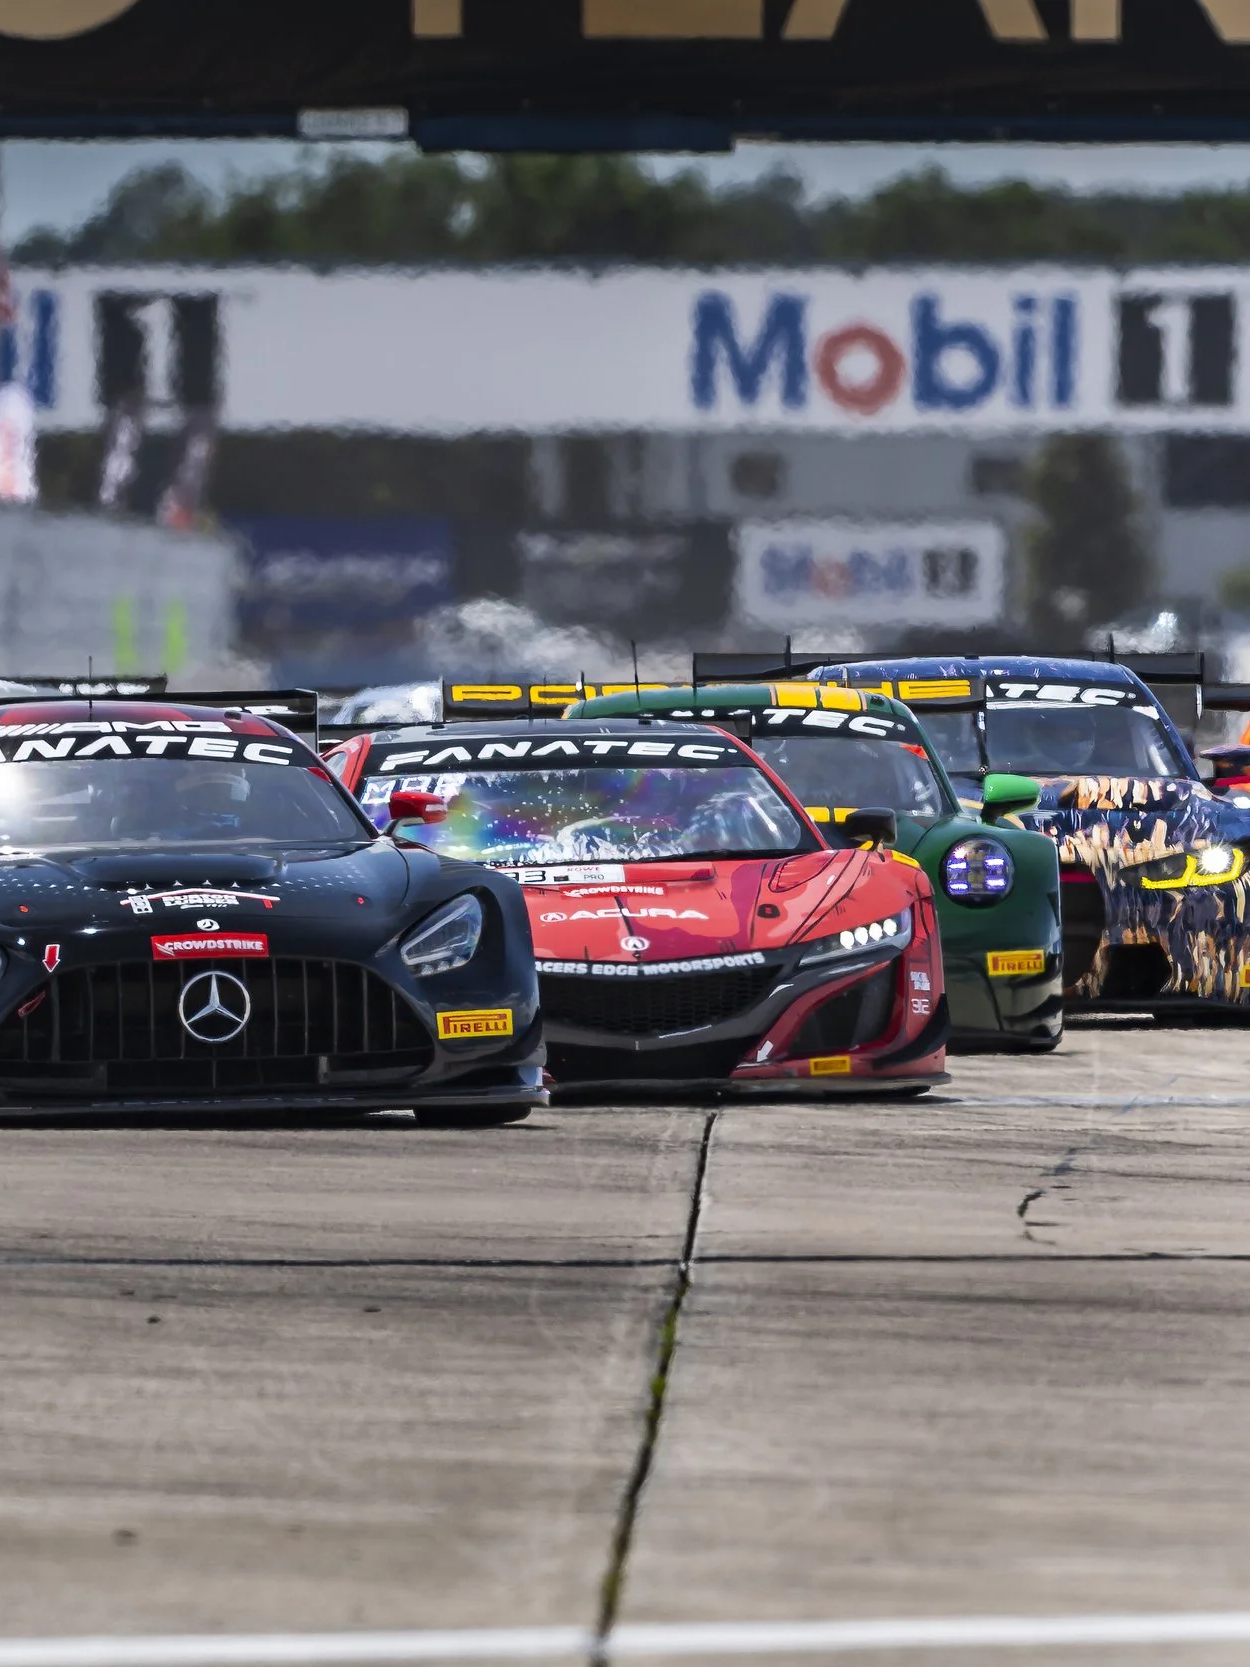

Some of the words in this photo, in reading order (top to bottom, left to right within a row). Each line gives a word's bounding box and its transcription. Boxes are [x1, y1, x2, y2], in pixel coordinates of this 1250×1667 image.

[690, 288, 1078, 416] Mobil
[1146, 299, 1193, 402] 1
[50, 721, 233, 734] AMG
[380, 740, 726, 771] FANATEC
[569, 908, 710, 920] ACURA
[162, 939, 264, 953] CROWDSTRIKE
[535, 961, 588, 976] ACERS
[592, 963, 638, 976] EDGE
[642, 952, 766, 976] MOTORSPORTS
[992, 953, 1043, 971] PIRELLI
[442, 1013, 507, 1034] PIRELLI
